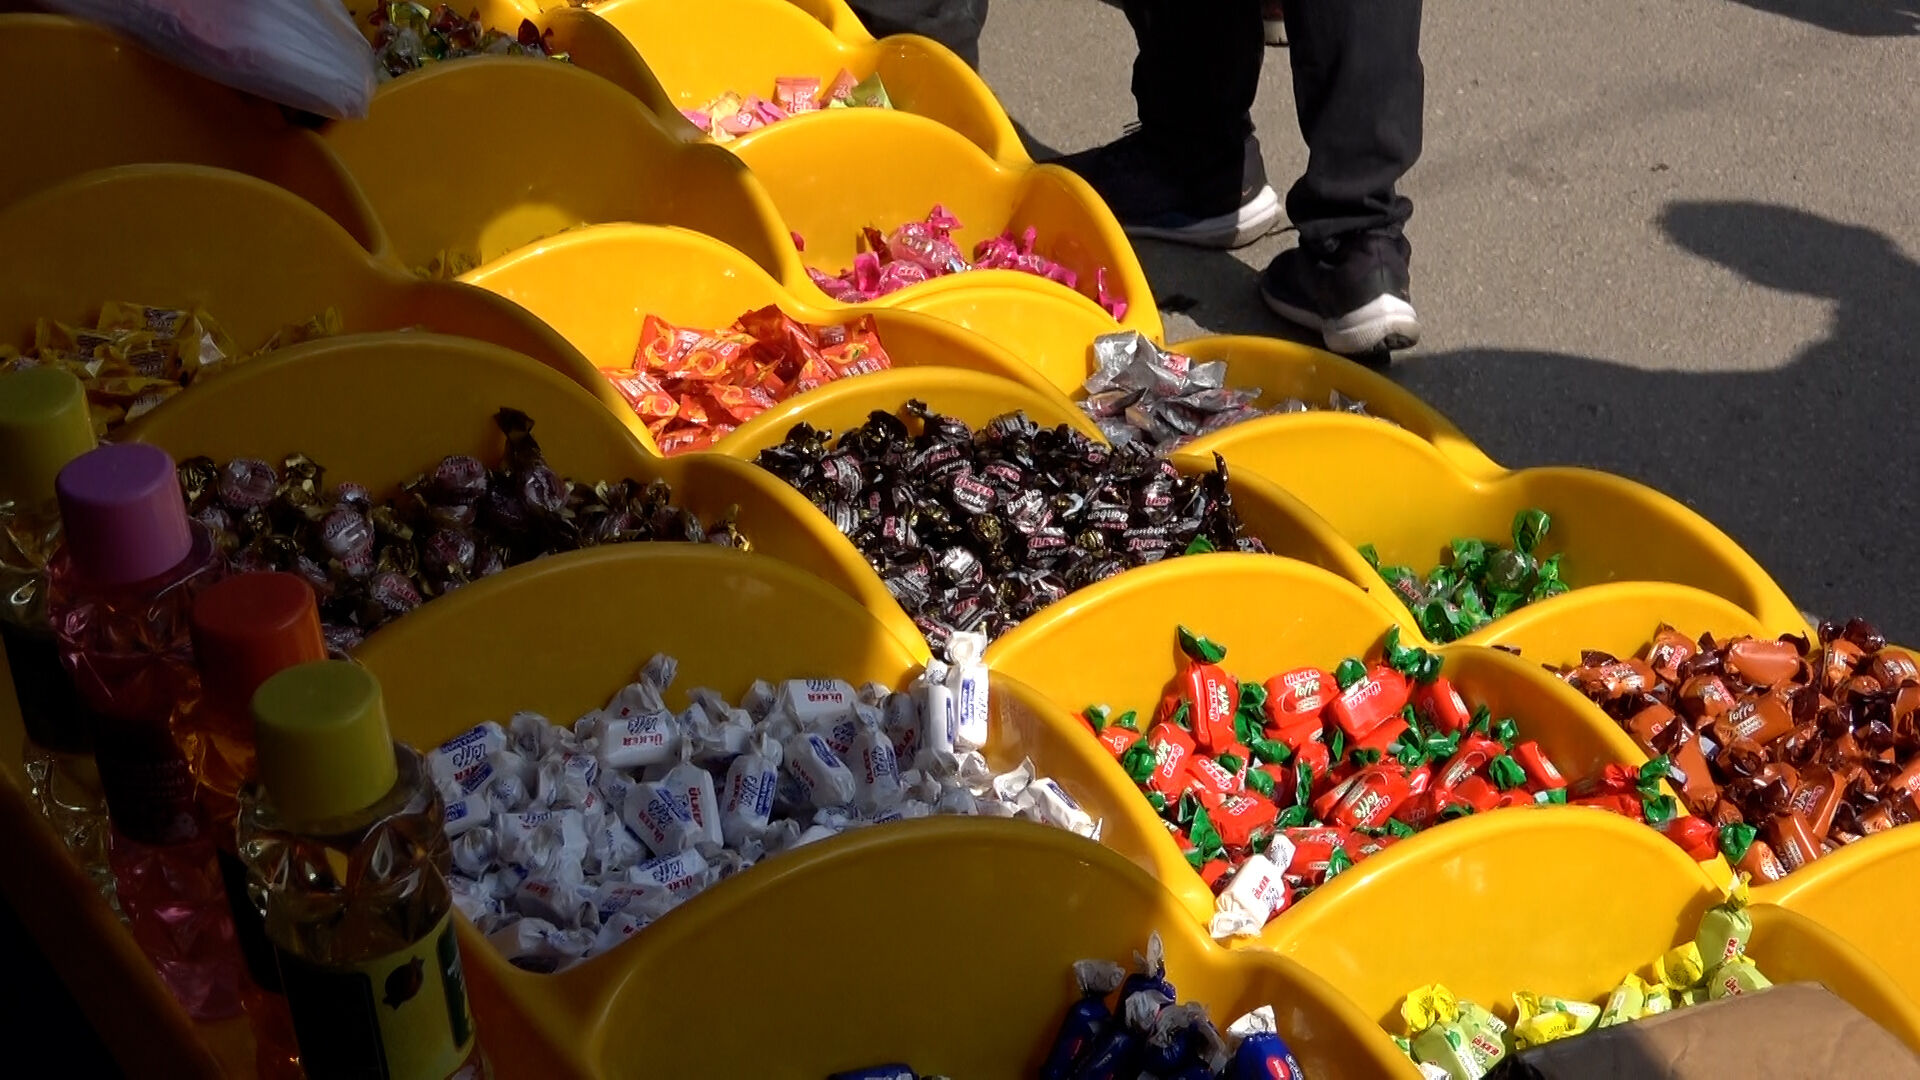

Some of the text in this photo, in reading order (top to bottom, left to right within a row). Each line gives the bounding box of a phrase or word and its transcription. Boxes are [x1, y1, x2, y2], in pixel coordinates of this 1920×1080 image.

[1293, 680, 1322, 699] Toffe
[808, 692, 843, 704] ÜLKER
[622, 733, 663, 747] ÜLKER
[638, 808, 665, 844] ÜLKER
